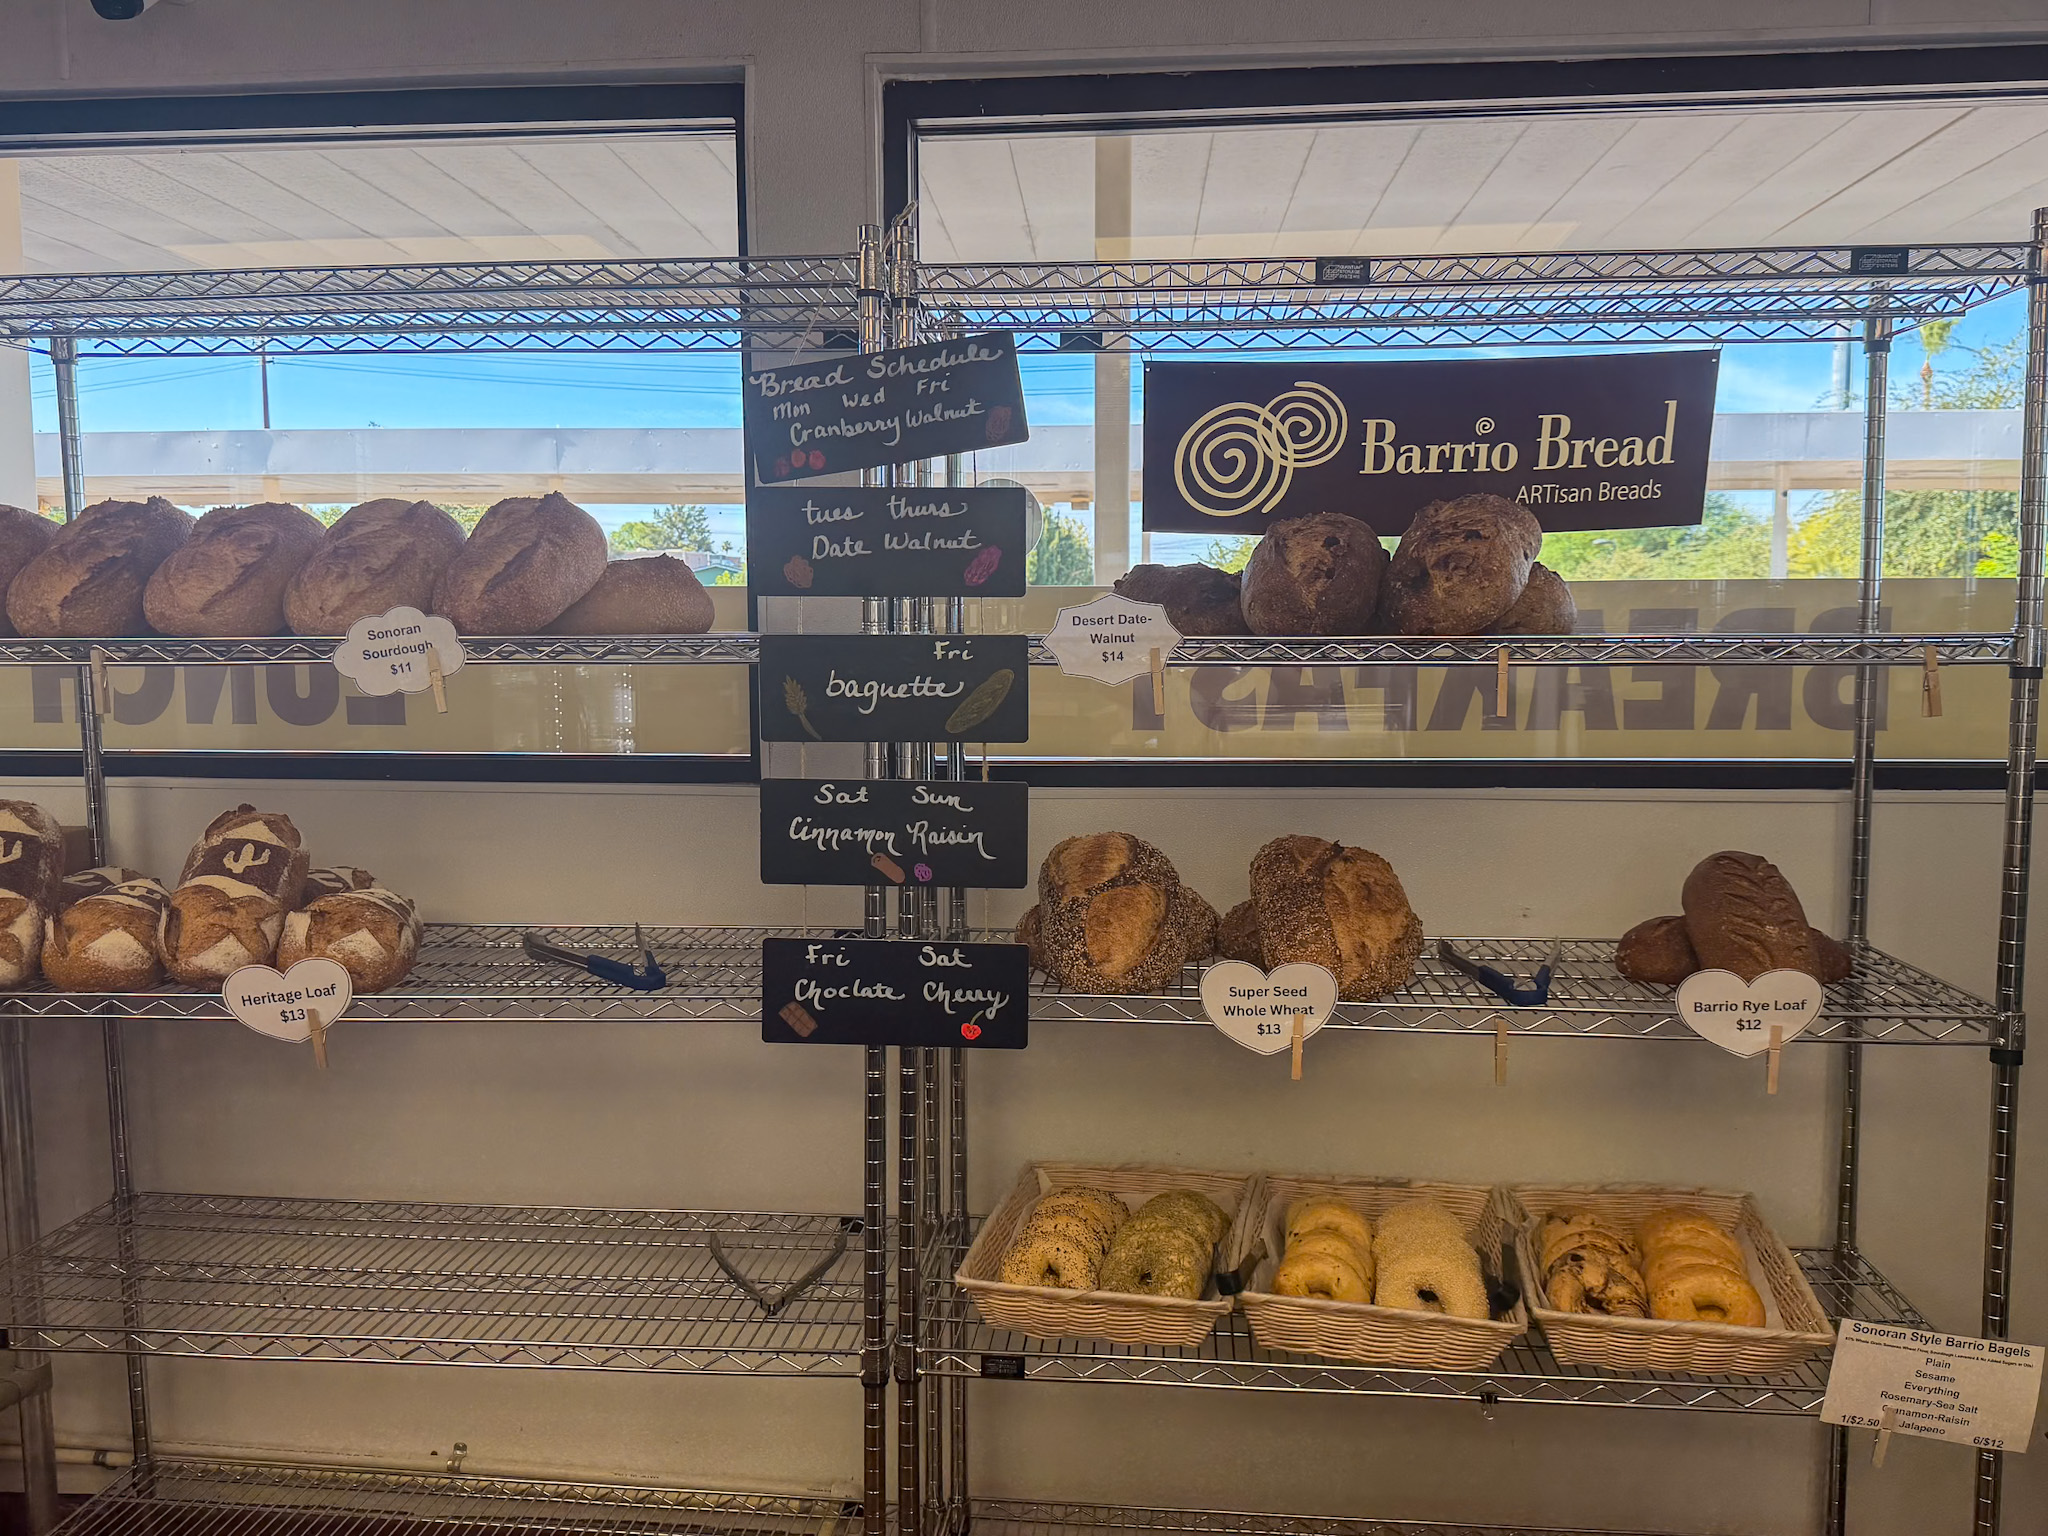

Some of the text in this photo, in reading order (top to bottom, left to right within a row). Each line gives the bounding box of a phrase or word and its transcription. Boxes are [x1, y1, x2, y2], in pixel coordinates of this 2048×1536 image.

[749, 343, 1003, 397] Bread Schedule
[916, 372, 951, 396] Fri
[790, 398, 986, 447] Cranberry Walnut
[1359, 400, 1678, 475] Barrio Bread
[1515, 479, 1662, 505] ARTisan Breads
[801, 499, 864, 526] tues
[812, 529, 982, 560] Date Walnut
[1072, 614, 1153, 627] Desert Date-
[362, 624, 434, 661] Sonoran Sourdough
[1090, 633, 1135, 644] Walnut
[933, 640, 974, 661] Fri
[1102, 651, 1124, 663] $14
[390, 662, 412, 675] $11
[825, 669, 965, 714] baguette
[813, 783, 974, 812] Sat Sun
[789, 816, 997, 860] Cinnamon Raisin
[805, 943, 973, 968] Fri Sat
[241, 983, 337, 1007] Heritage Loaf
[794, 978, 1010, 1020] Choclate Cherry
[1229, 986, 1307, 1000] Super Seed
[280, 1008, 306, 1023] $13
[1223, 1004, 1315, 1016] Whole Wheat
[1693, 999, 1807, 1014] Barrio Rye Loaf
[1257, 1023, 1281, 1036] $13
[1736, 1018, 1762, 1032] $12
[1852, 1322, 2031, 1357] Sonoran Style Barrio Bagels
[1925, 1357, 1951, 1369] Plain
[1915, 1369, 1956, 1383] Sesame
[1904, 1381, 1960, 1399] Everything
[1880, 1391, 1978, 1414] Rosemary-Sea Salt
[1841, 1414, 1880, 1427] 1/$2.50
[1882, 1404, 1970, 1426] Cnamon-Raisin
[1899, 1420, 1946, 1435] Jalapeno
[1973, 1436, 2004, 1448] 6/$12
